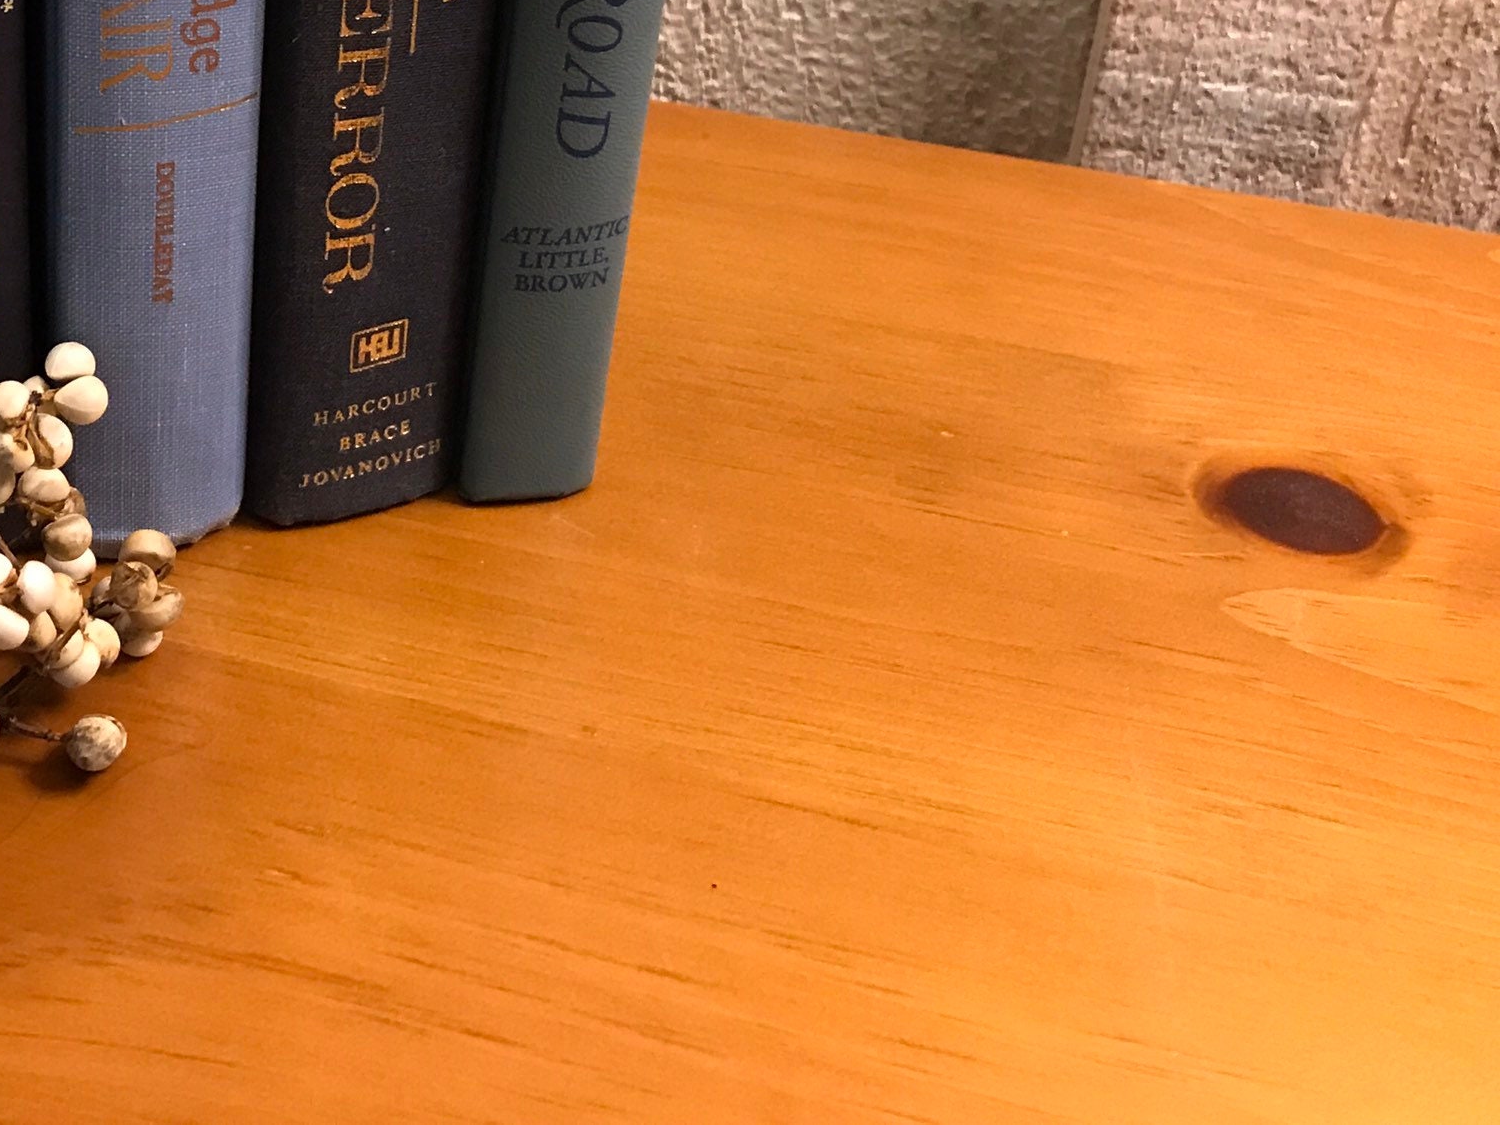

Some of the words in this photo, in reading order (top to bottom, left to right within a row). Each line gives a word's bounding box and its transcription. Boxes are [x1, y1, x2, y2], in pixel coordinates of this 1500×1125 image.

[152, 161, 176, 304] DOUBLEDAY
[501, 215, 629, 246] ATLANTIC
[515, 267, 610, 292] BROWN
[313, 382, 437, 426] HARCOURT
[339, 419, 411, 452] BRACE
[299, 438, 441, 488] JOVANOVICH
